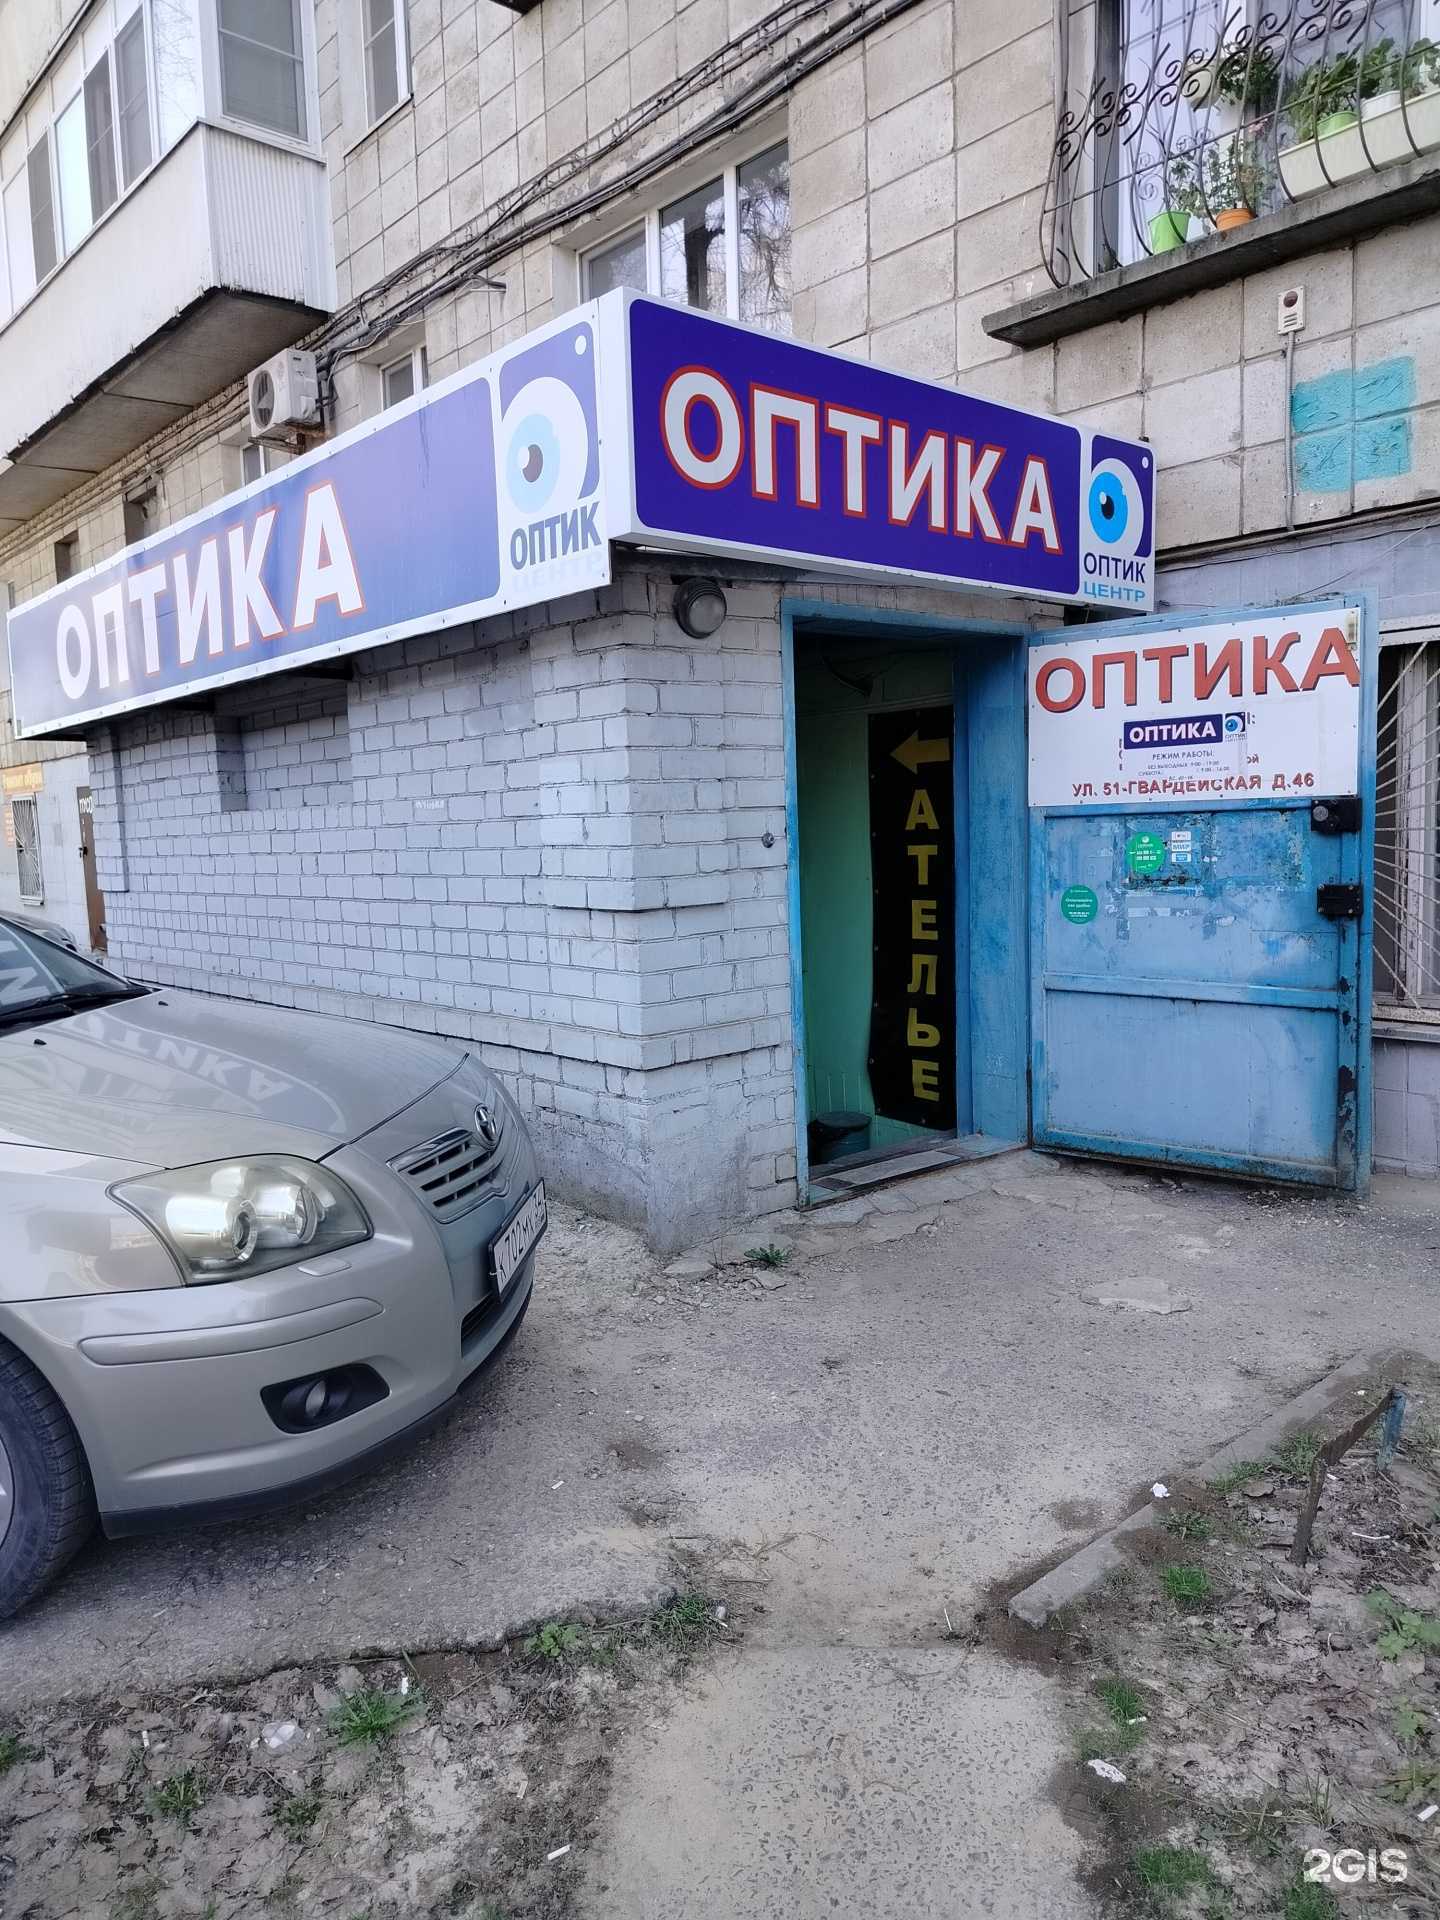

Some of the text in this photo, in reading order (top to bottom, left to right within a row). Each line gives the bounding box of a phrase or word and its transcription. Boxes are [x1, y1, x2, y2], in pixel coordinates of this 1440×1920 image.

[660, 364, 1063, 554] ОПТИКА
[510, 501, 602, 570] ОПТИК
[56, 480, 366, 700] ОПТИКА
[1083, 552, 1146, 583] ОПТИК
[1084, 581, 1146, 602] ЦЕНТР
[1035, 627, 1360, 713] ОПТИКА
[1129, 721, 1217, 743] ОПТИКА
[1152, 752, 1180, 761] РЕЖИМ
[1072, 783, 1098, 797] УЛ.
[1271, 772, 1314, 791] Д.46
[905, 789, 941, 1101] АТЕЛЬЕ
